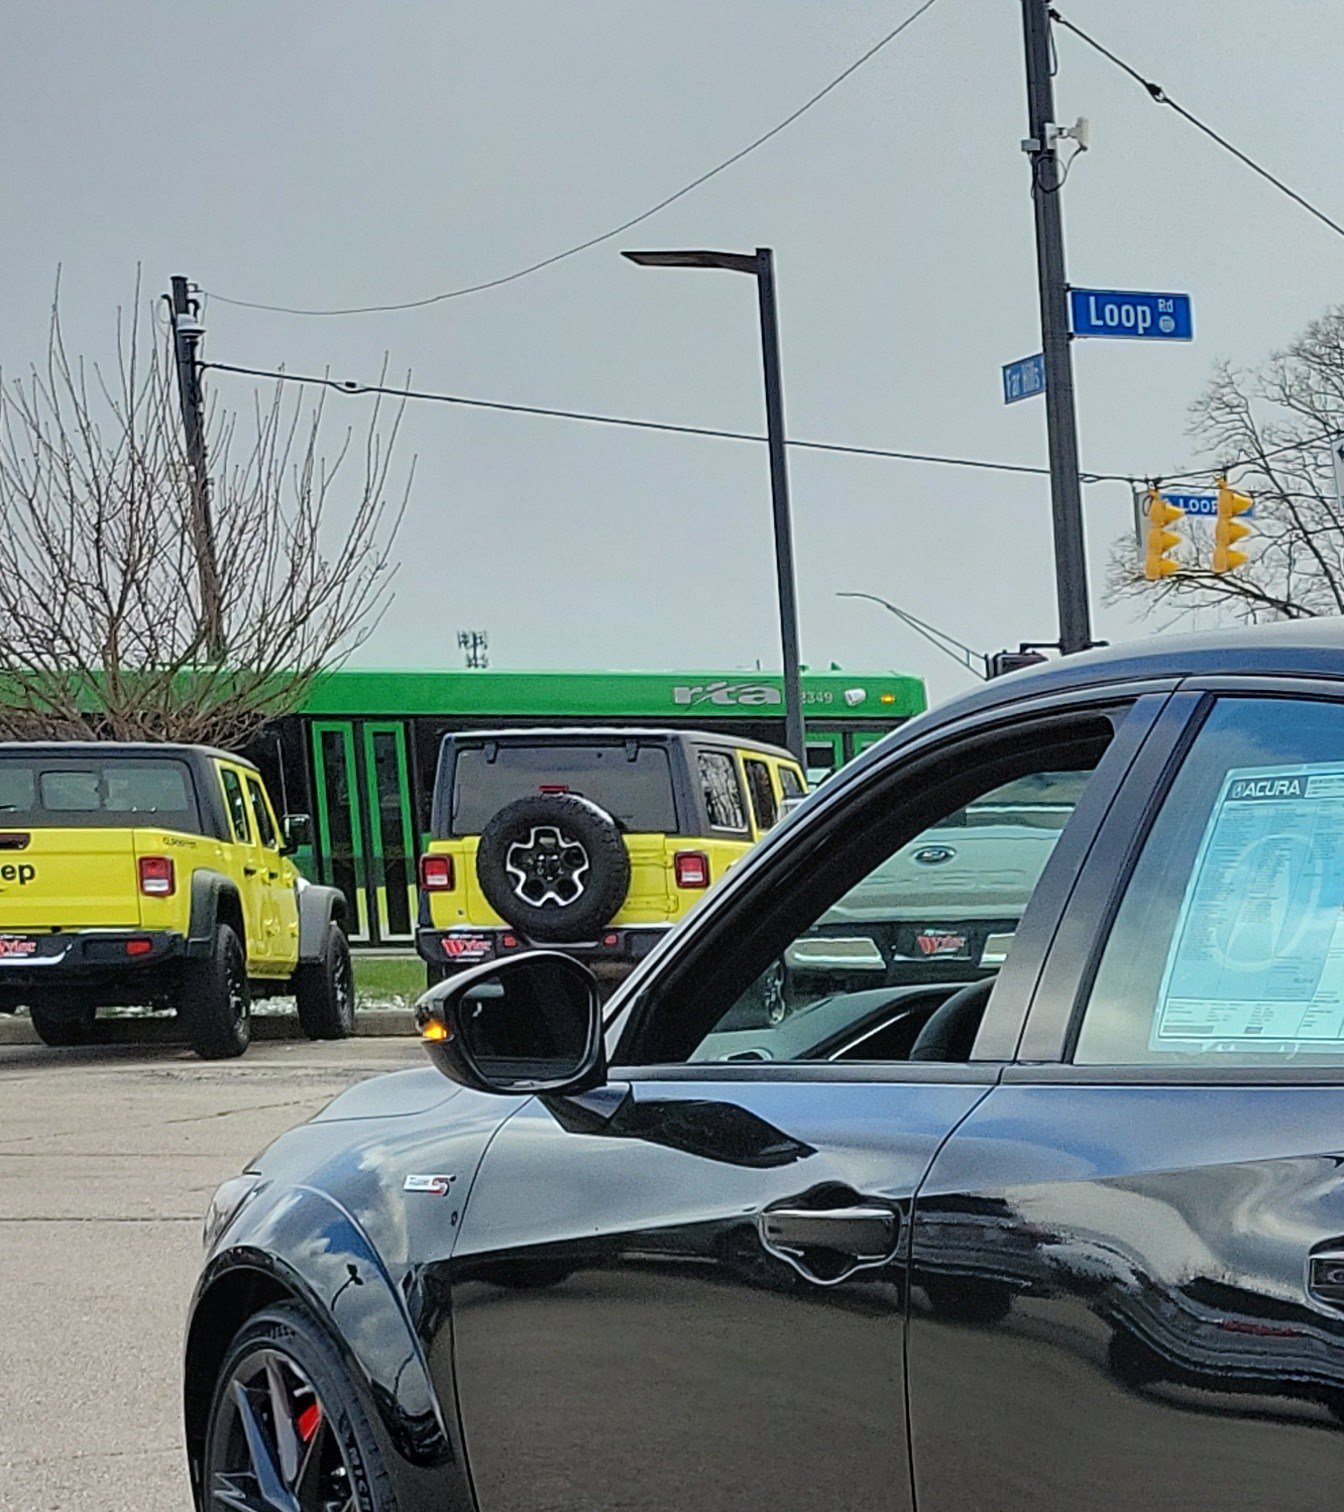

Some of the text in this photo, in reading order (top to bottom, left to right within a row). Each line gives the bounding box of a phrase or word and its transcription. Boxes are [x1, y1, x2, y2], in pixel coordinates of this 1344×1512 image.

[1089, 296, 1152, 335] Loop
[1158, 298, 1174, 313] Rd
[673, 681, 783, 707] rta
[1243, 779, 1301, 798] ACURA
